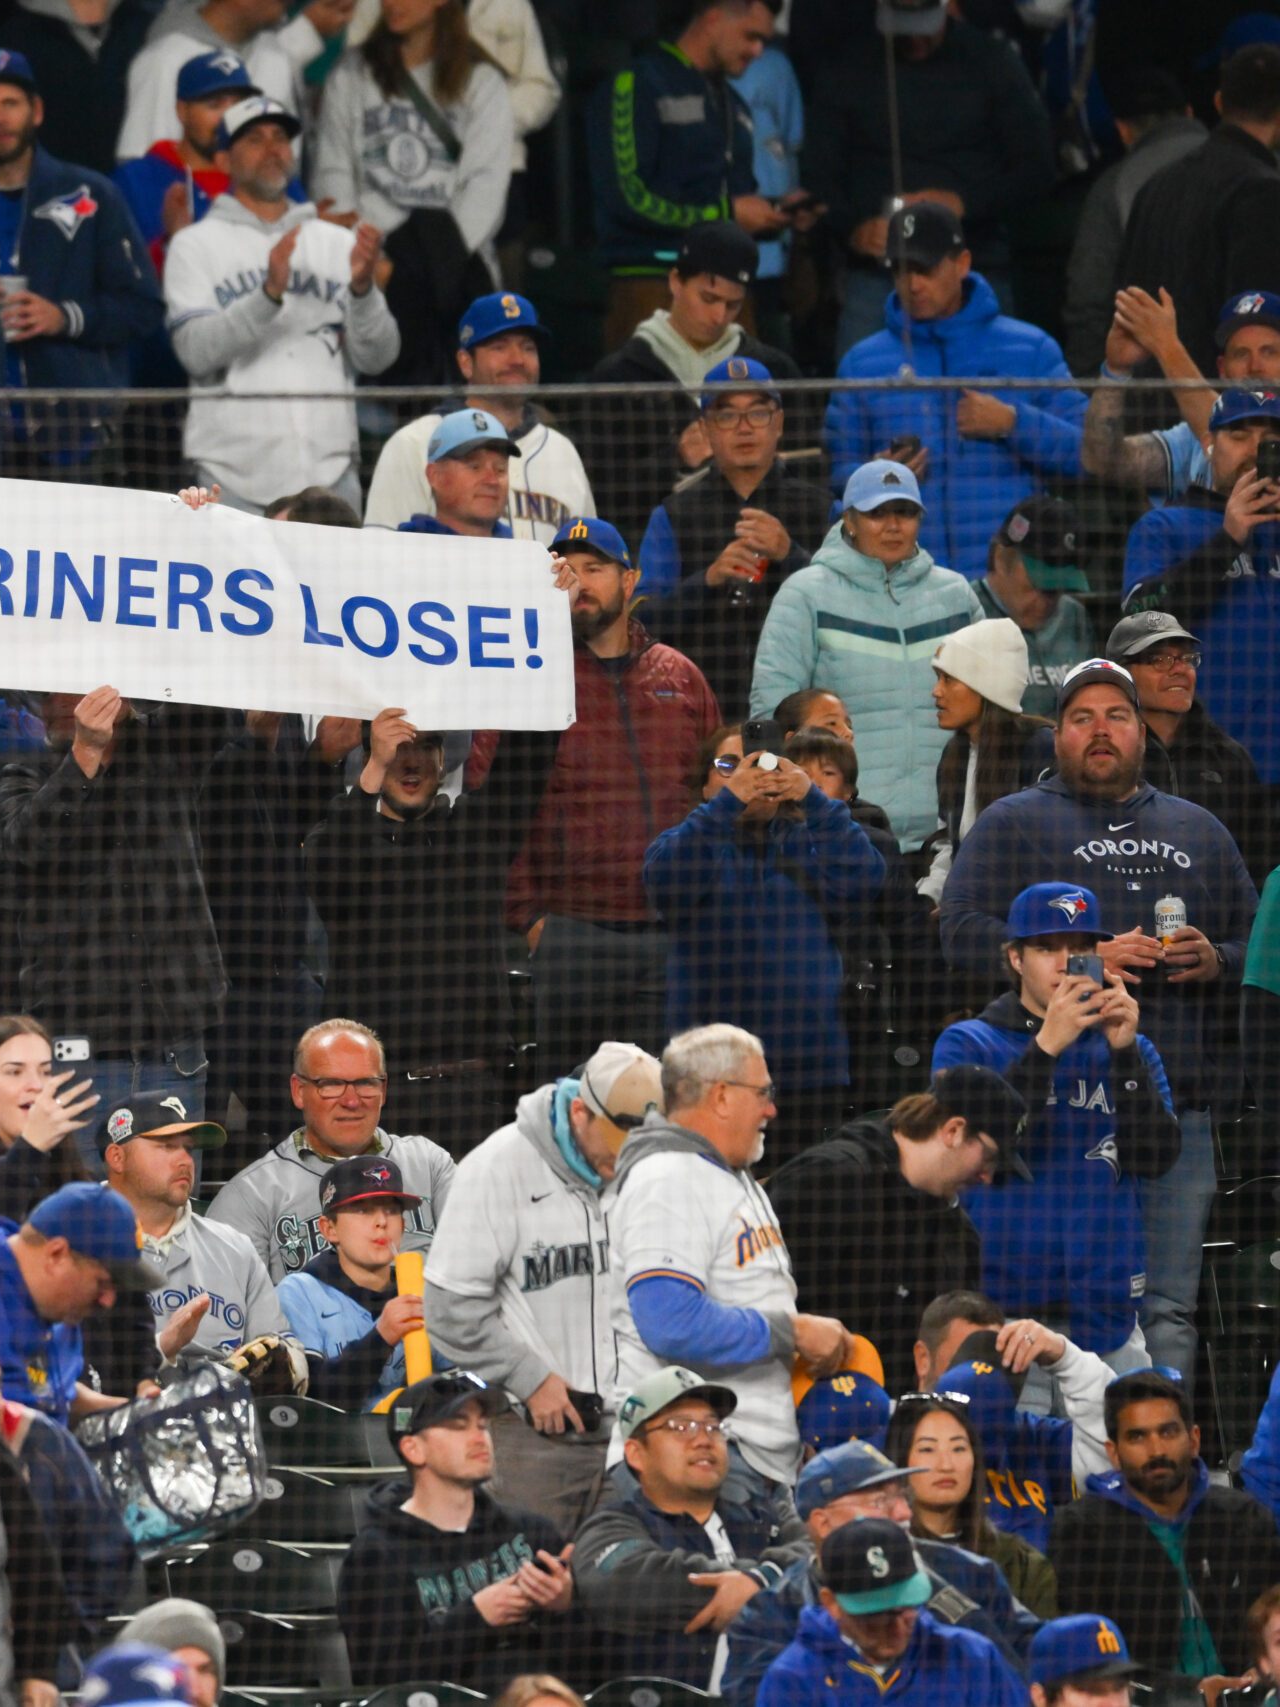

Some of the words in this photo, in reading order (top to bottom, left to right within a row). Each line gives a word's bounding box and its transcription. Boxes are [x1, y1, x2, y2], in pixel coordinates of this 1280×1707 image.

[214, 268, 270, 308] BLU
[299, 583, 544, 670] LOSE!
[1073, 837, 1191, 869] TORONTO
[1107, 864, 1165, 875] BASEBALL
[866, 1545, 890, 1578] S
